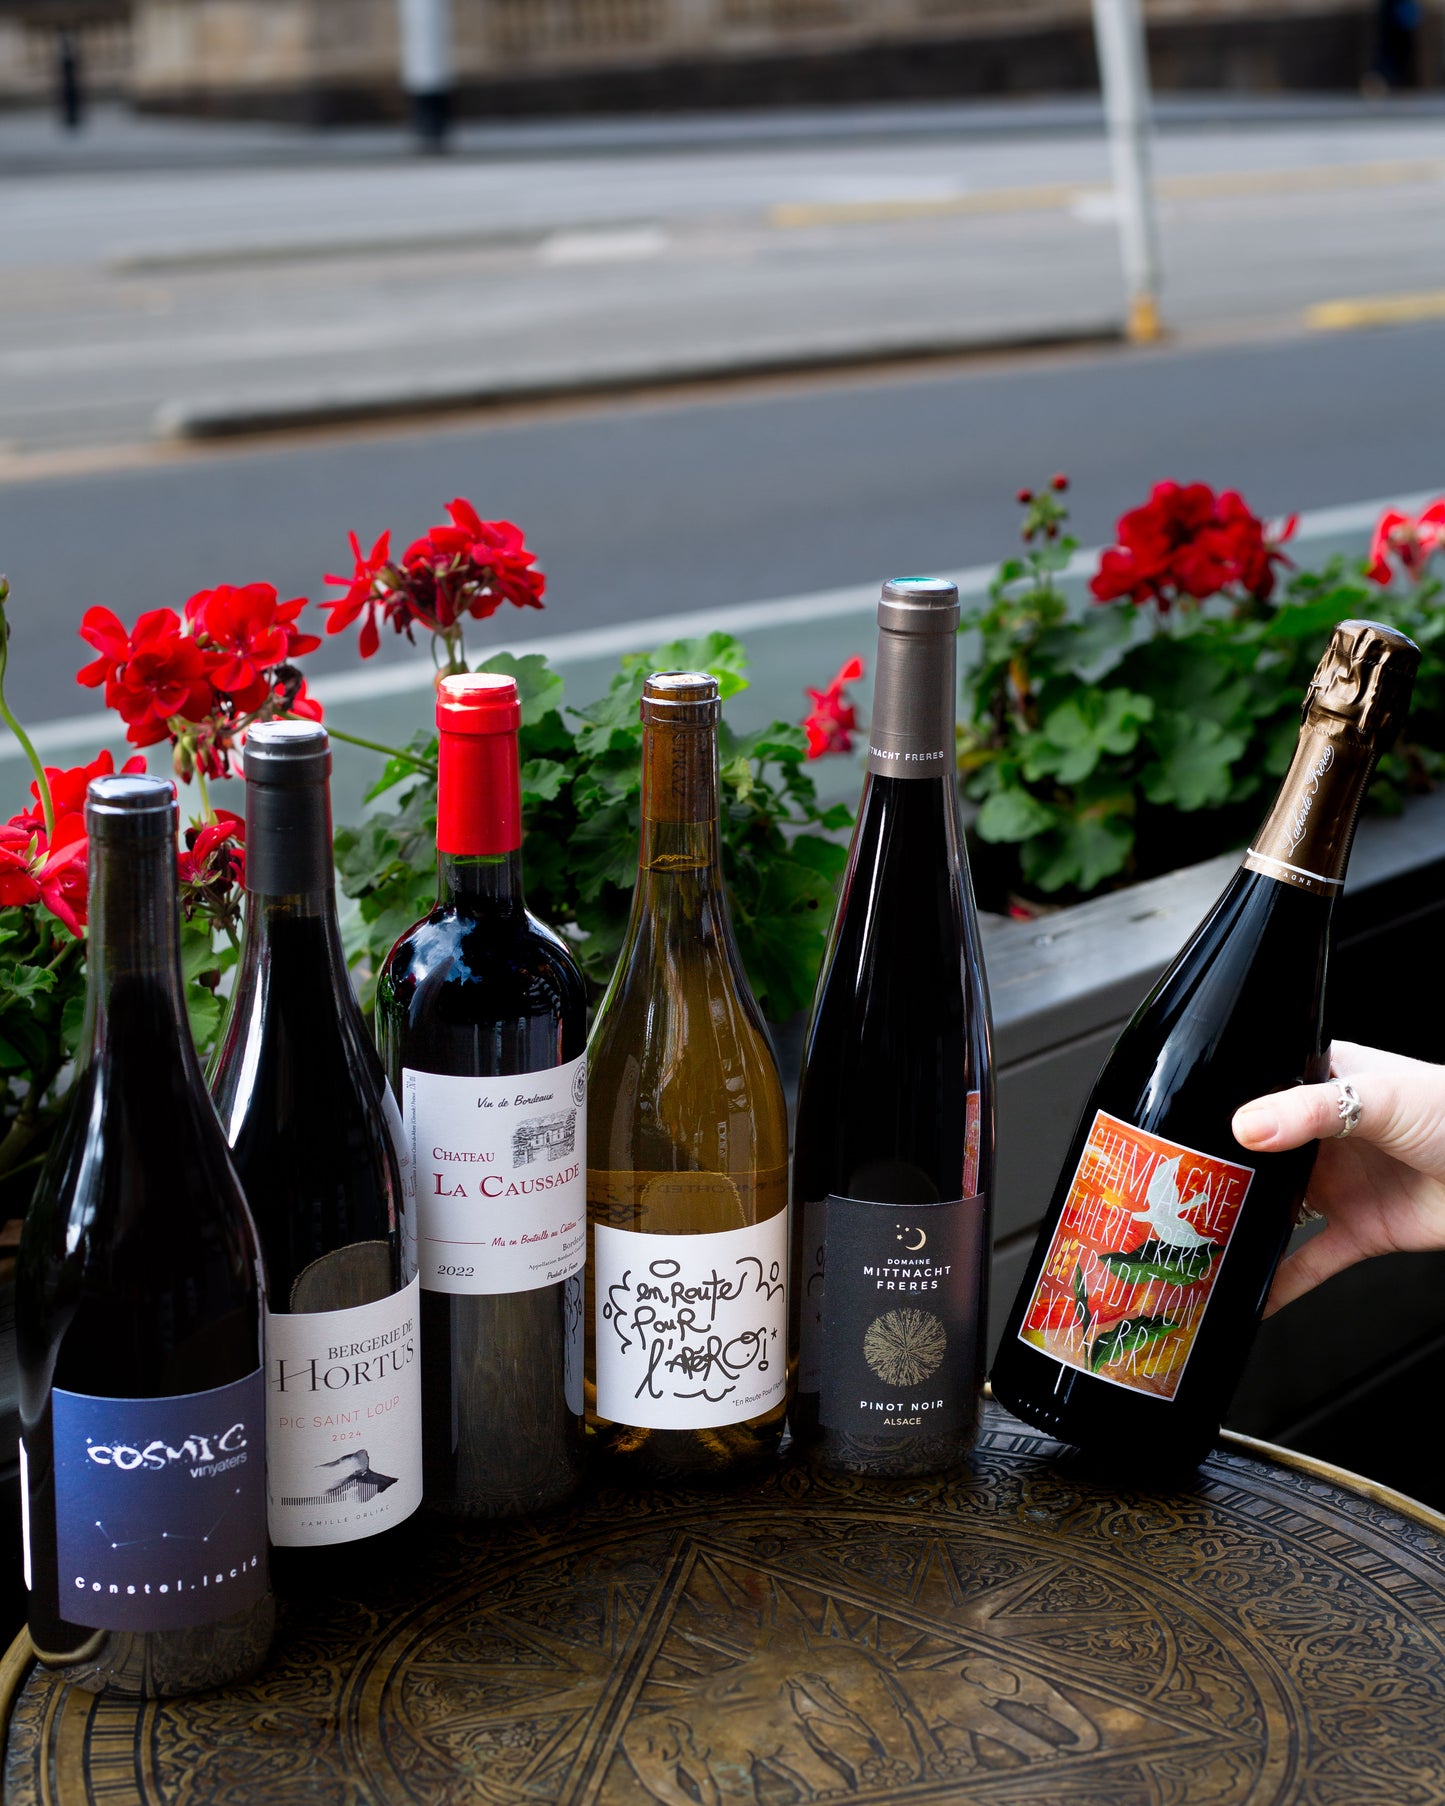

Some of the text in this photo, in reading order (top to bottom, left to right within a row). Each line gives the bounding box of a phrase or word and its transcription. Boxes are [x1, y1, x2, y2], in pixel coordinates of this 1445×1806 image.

[869, 746, 944, 761] TNACHT FRERES
[477, 1092, 554, 1108] Vin de Bordeaux
[479, 1162, 580, 1198] CAUSSADE
[1082, 1128, 1239, 1233] CHAMPAGNE
[1065, 1186, 1134, 1254] LAHERTE
[520, 1230, 549, 1244] Bouteille
[887, 1258, 931, 1266] DOMAINE
[437, 1264, 475, 1277] 2022
[863, 1265, 952, 1278] MITTNACHT
[636, 1283, 670, 1304] en
[877, 1280, 939, 1291] FRERES
[328, 1318, 413, 1361] BERGERIE DE
[1028, 1283, 1184, 1383] EXTRA-BRUT
[279, 1396, 401, 1429] PIC SAINT LOUP
[860, 1400, 944, 1412] PINOT NOIR
[883, 1417, 922, 1426] ALSACE
[332, 1431, 362, 1442] 2024
[190, 1452, 248, 1478] vinyaters
[301, 1504, 390, 1527] FAMILLE ORLIAC
